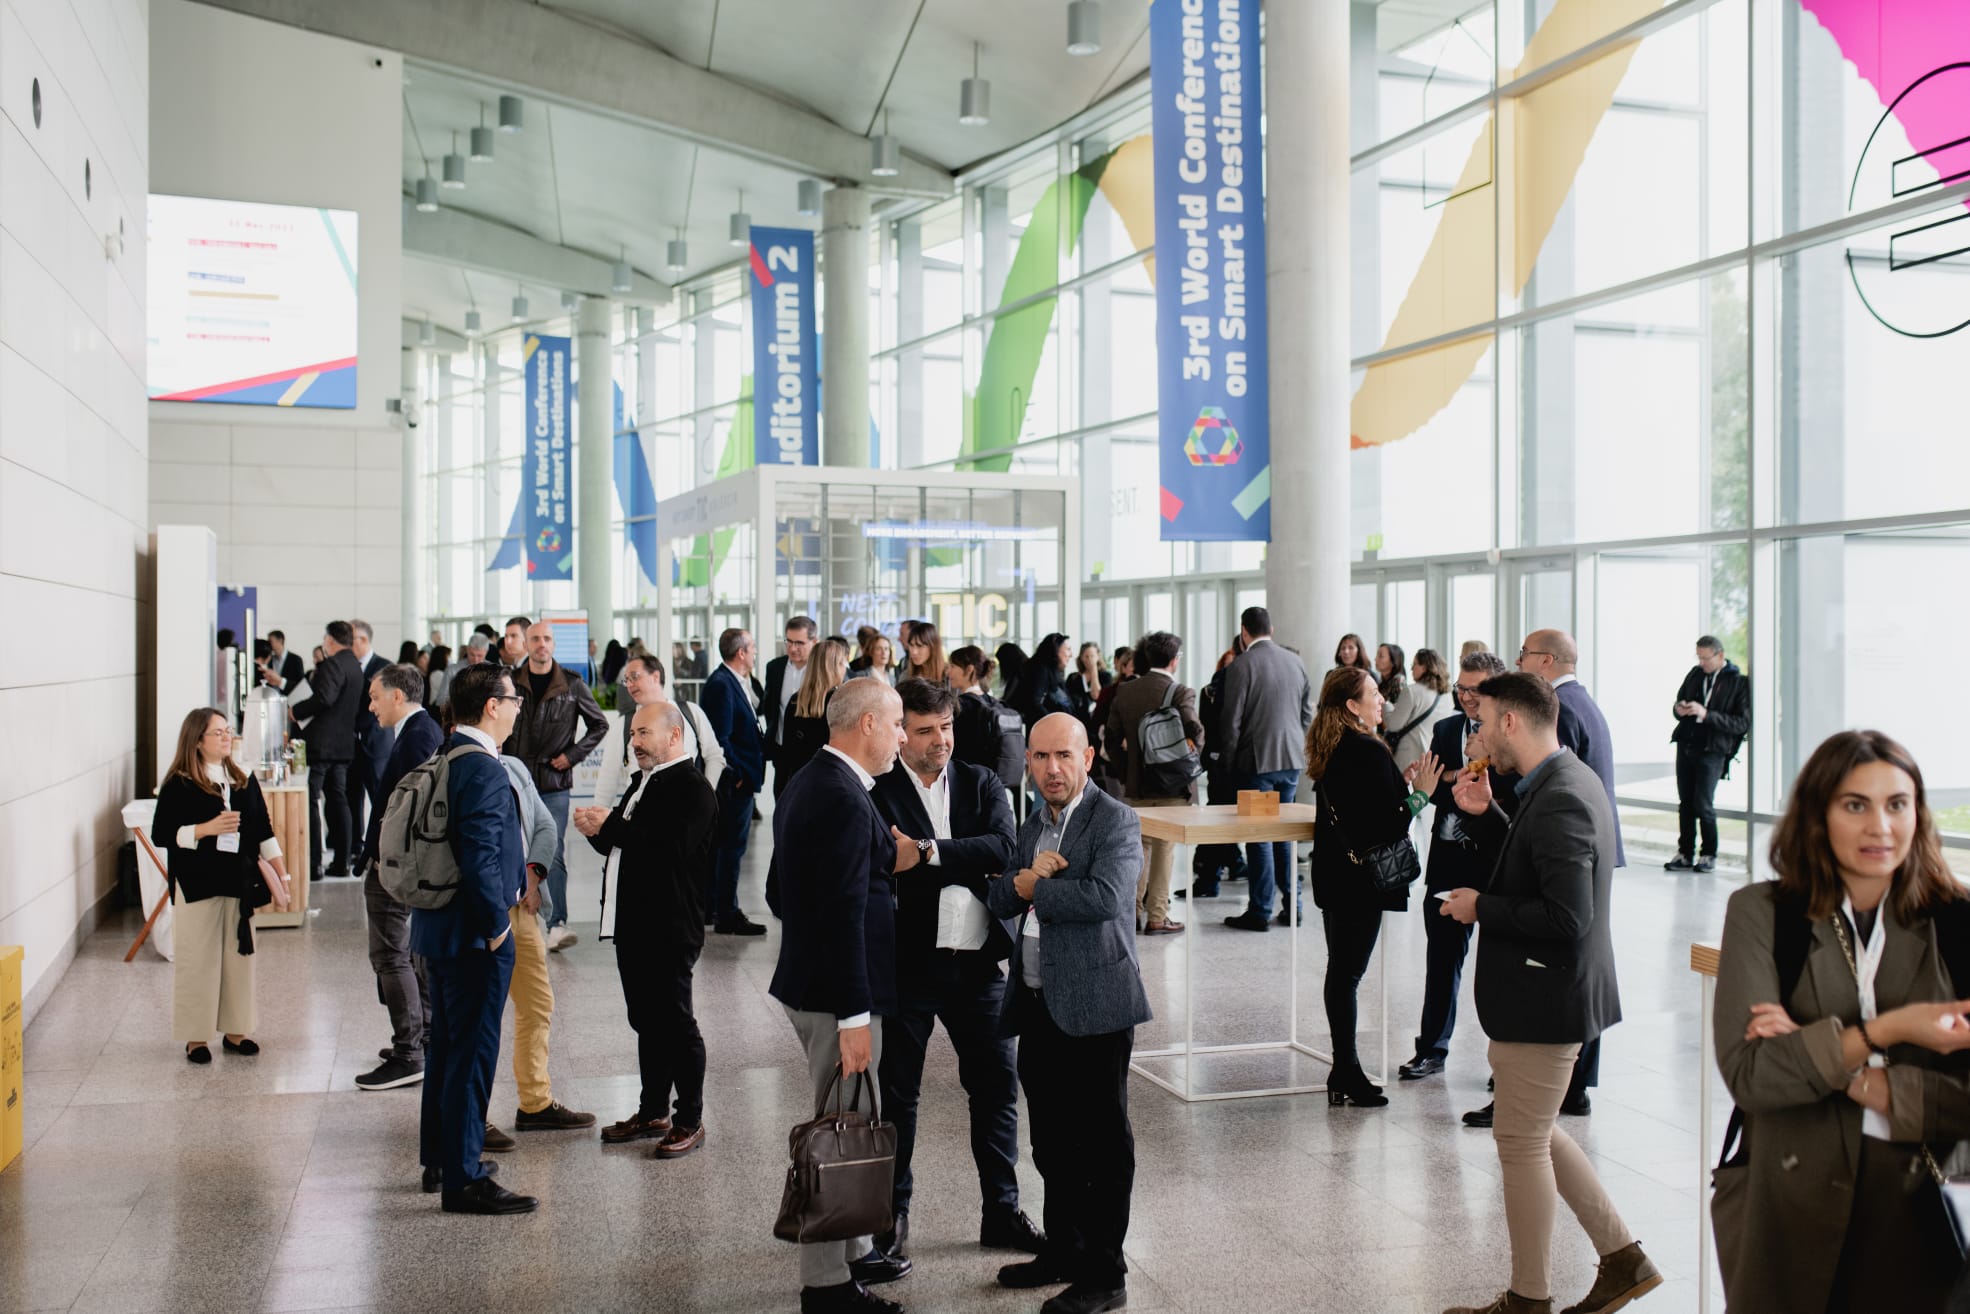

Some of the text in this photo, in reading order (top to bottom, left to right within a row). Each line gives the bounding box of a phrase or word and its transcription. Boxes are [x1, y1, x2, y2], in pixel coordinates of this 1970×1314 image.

[767, 245, 799, 273] 2
[1177, 194, 1210, 306] World
[1217, 224, 1247, 341] Smart
[1180, 315, 1212, 381] 3rd
[1225, 351, 1248, 398] on
[533, 350, 549, 517] 3rd World Conference
[550, 351, 565, 524] on Smart Destinations
[930, 592, 1008, 638] TIC
